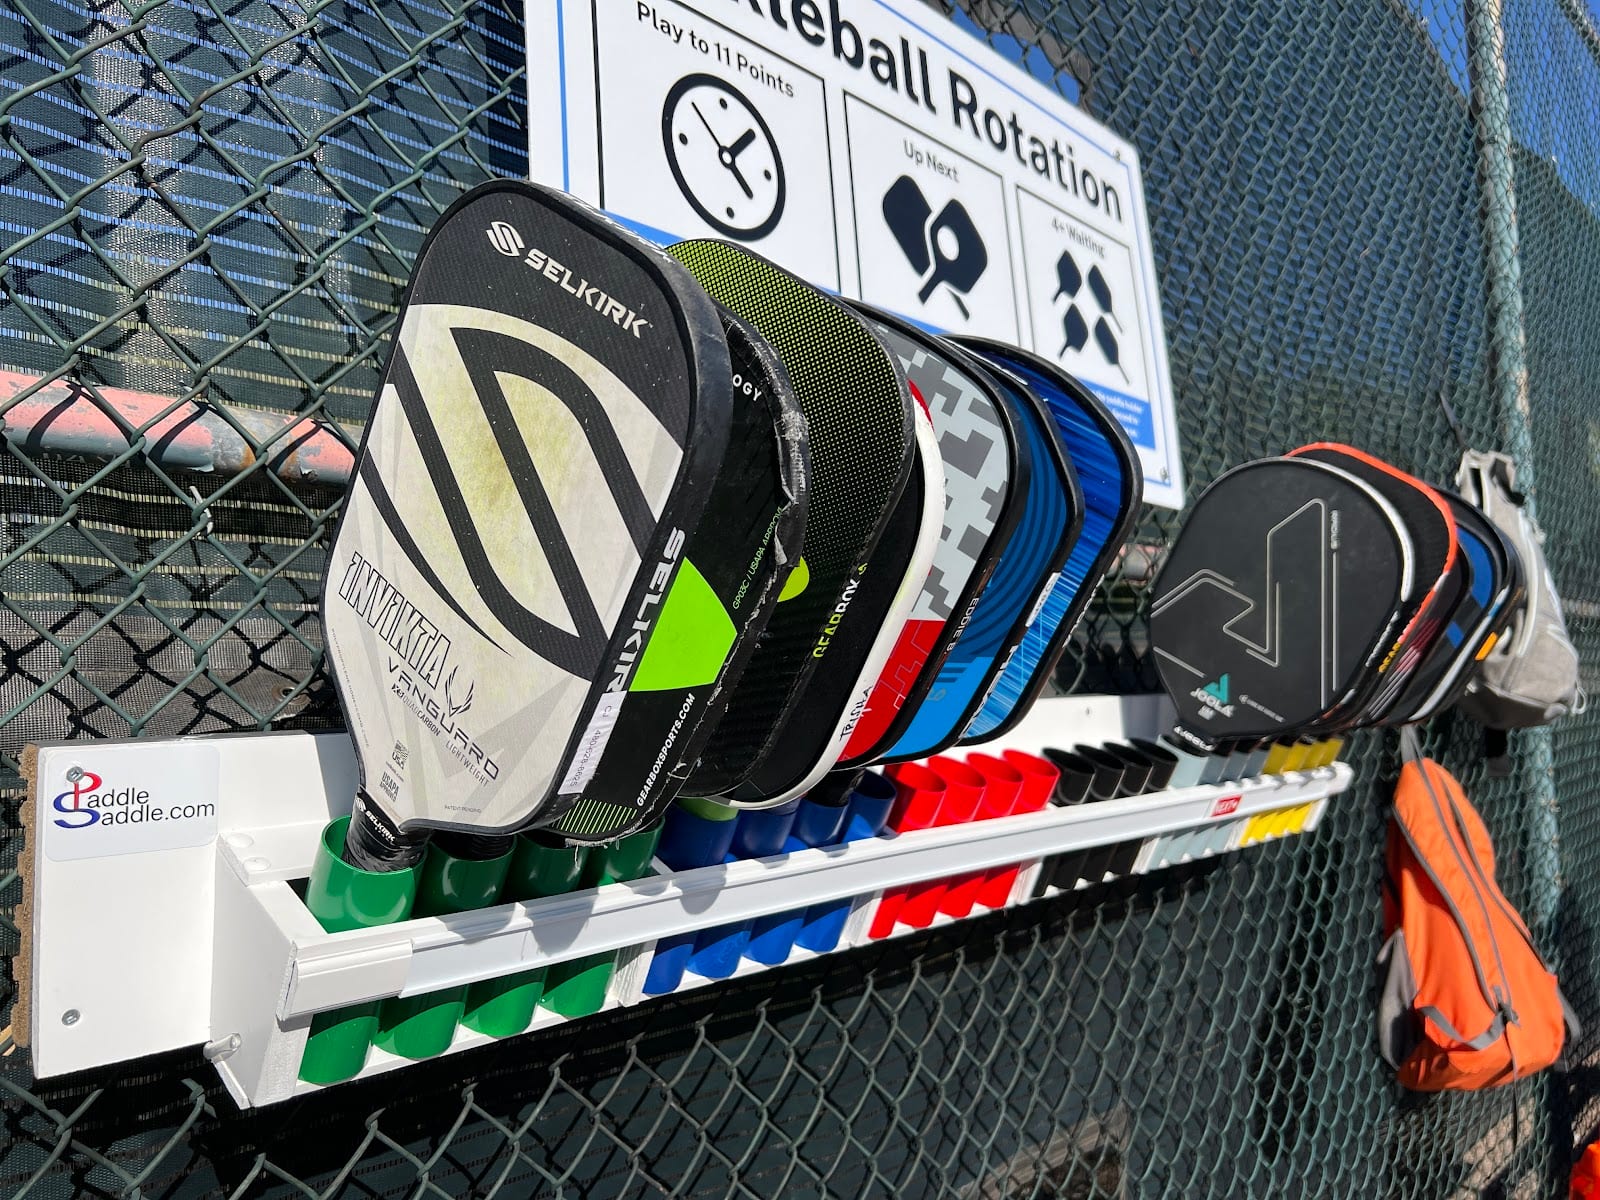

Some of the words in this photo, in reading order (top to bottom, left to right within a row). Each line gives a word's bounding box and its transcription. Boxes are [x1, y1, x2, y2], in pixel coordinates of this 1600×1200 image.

[637, 1, 683, 45] Play
[689, 30, 709, 54] to
[714, 43, 731, 66] 11
[738, 53, 794, 98] Points
[735, 0, 937, 115] eball
[948, 68, 1123, 224] Rotation
[904, 139, 924, 168] Up
[927, 154, 960, 184] Next
[1066, 223, 1105, 260] Waiting
[524, 248, 651, 339] SELKIRK
[732, 374, 762, 402] OGY
[749, 547, 766, 578] USAPA
[338, 551, 452, 690] INVIKTA
[606, 526, 686, 693] SELKIR
[387, 655, 501, 781] VANGUARD
[1190, 688, 1235, 718] JOOLA
[445, 740, 490, 787] LIGHTWEIGHT
[636, 692, 697, 808] GEARBOXSPORTS.COM
[52, 790, 216, 829] Saddle.com
[74, 771, 150, 811] Paddle
